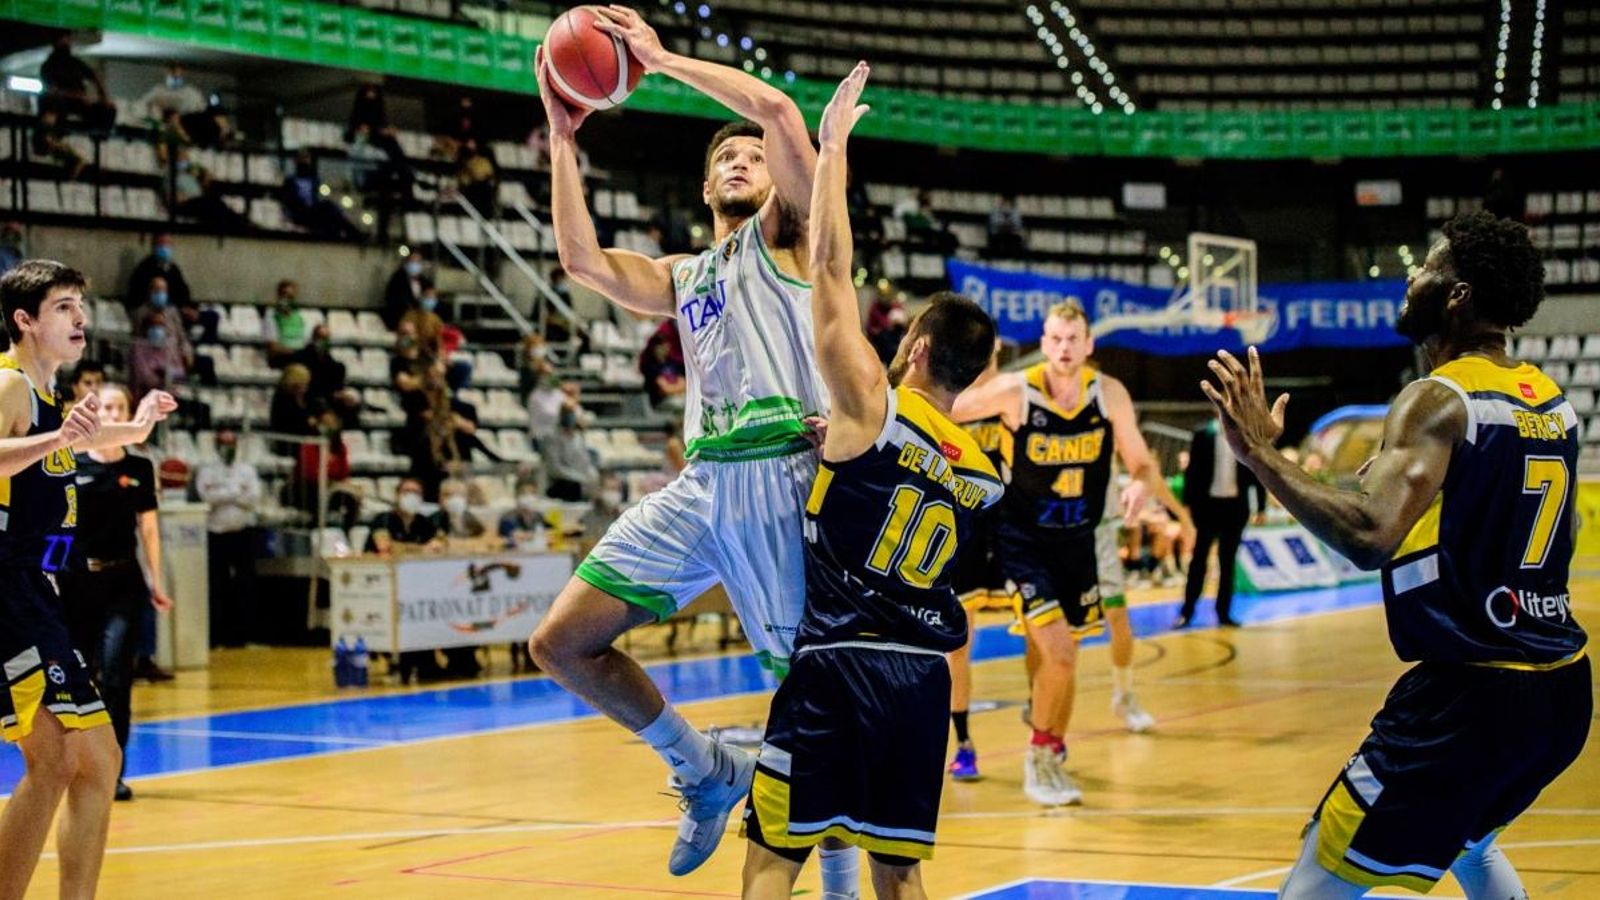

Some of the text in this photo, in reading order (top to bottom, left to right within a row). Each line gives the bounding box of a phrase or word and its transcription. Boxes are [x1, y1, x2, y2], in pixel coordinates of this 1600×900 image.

[1512, 410, 1567, 440] BERCY
[897, 441, 928, 474] DE
[1051, 468, 1085, 499] 41
[1519, 455, 1569, 569] 7
[865, 484, 958, 589] 10
